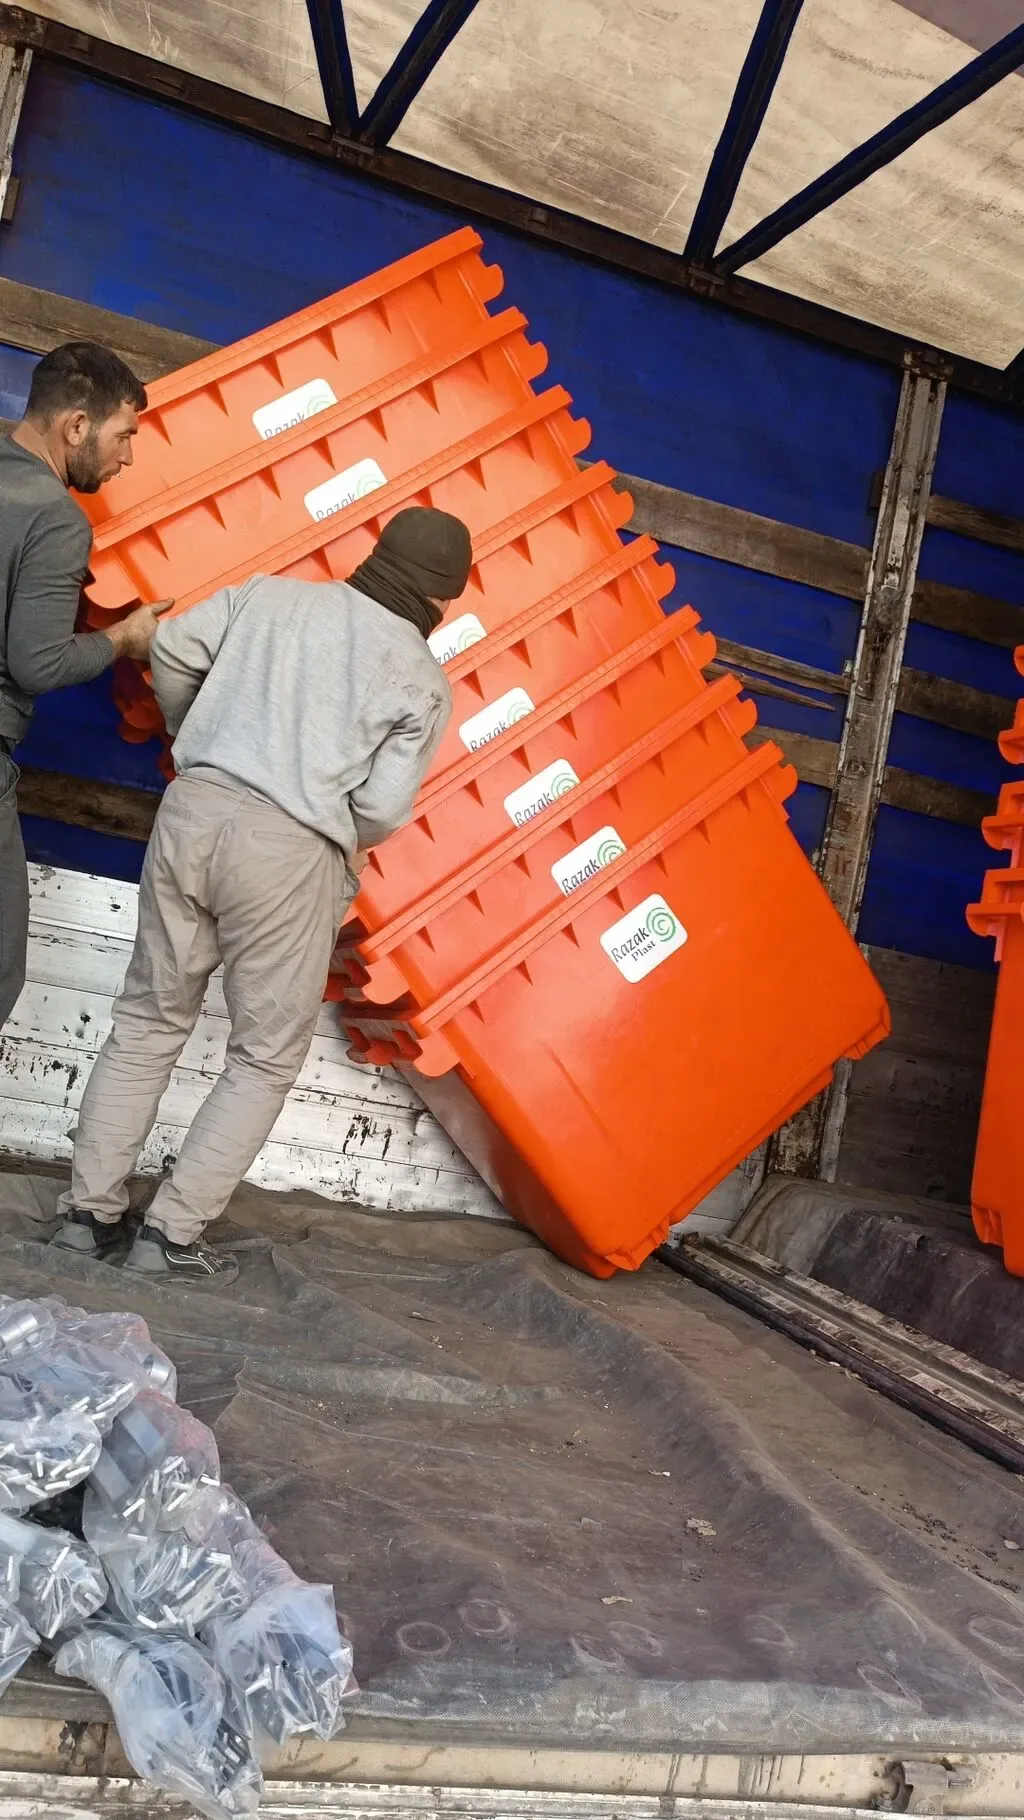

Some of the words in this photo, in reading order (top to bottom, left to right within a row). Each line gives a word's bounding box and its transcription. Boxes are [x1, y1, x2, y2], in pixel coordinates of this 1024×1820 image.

[470, 720, 508, 752] Razak
[514, 792, 553, 827] Razak
[561, 858, 601, 894] Razak
[611, 927, 650, 963] Razak
[631, 940, 657, 962] Plast
